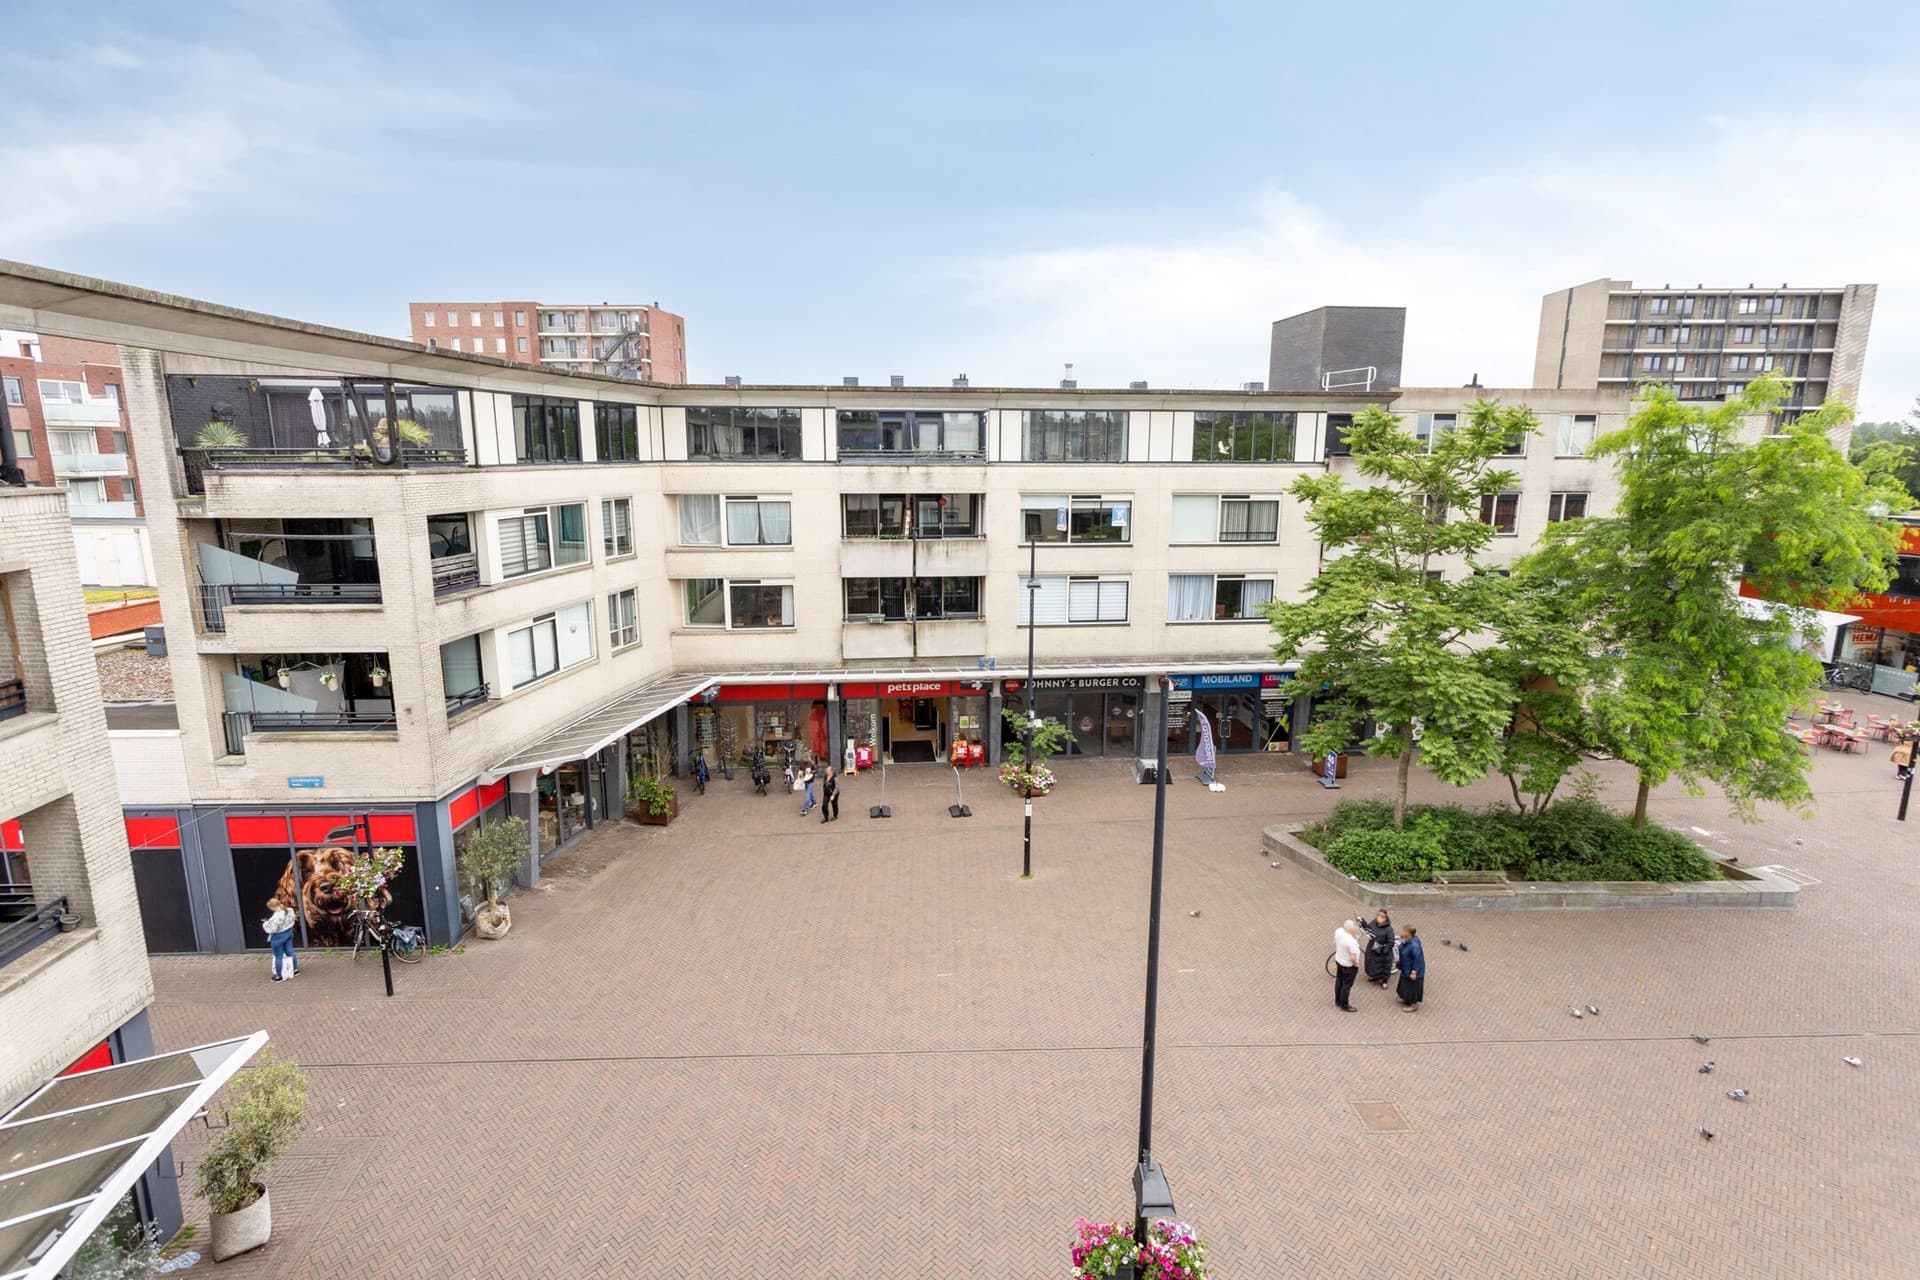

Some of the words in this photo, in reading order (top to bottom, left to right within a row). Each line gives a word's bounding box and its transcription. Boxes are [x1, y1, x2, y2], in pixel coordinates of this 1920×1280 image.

[1079, 678, 1119, 688] BURGER
[1122, 678, 1140, 687] CO.
[1201, 674, 1253, 684] MOBILAND
[868, 713, 877, 747] Welkom
